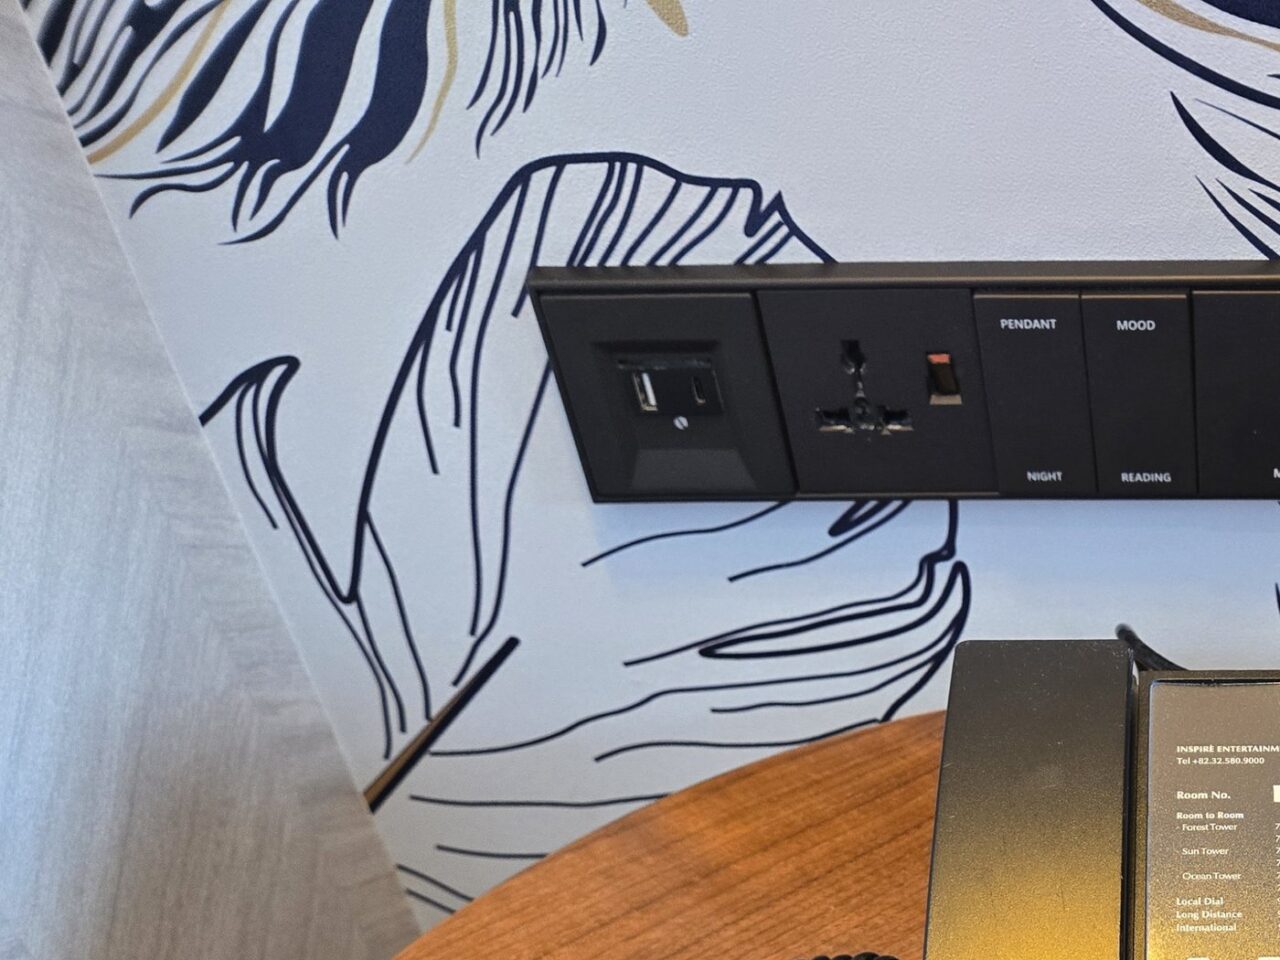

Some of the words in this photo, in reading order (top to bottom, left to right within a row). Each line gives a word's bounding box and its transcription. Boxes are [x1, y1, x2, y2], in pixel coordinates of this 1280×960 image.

[1000, 319, 1056, 330] PENDANT
[1116, 320, 1156, 331] MOOD
[1027, 471, 1062, 482] NIGHT
[1121, 472, 1172, 483] READING
[1192, 757, 1265, 765] +82.32.580.9000
[1177, 791, 1208, 800] Room
[1211, 791, 1231, 799] No.
[1217, 811, 1244, 819] Room
[1210, 823, 1238, 831] Tower
[1182, 872, 1212, 880] Ocean
[1214, 872, 1242, 880] Tower
[1176, 897, 1201, 905] Local
[1204, 897, 1224, 905] Dial
[1176, 911, 1200, 920] Long
[1202, 910, 1243, 918] Distance
[1176, 923, 1237, 932] International
